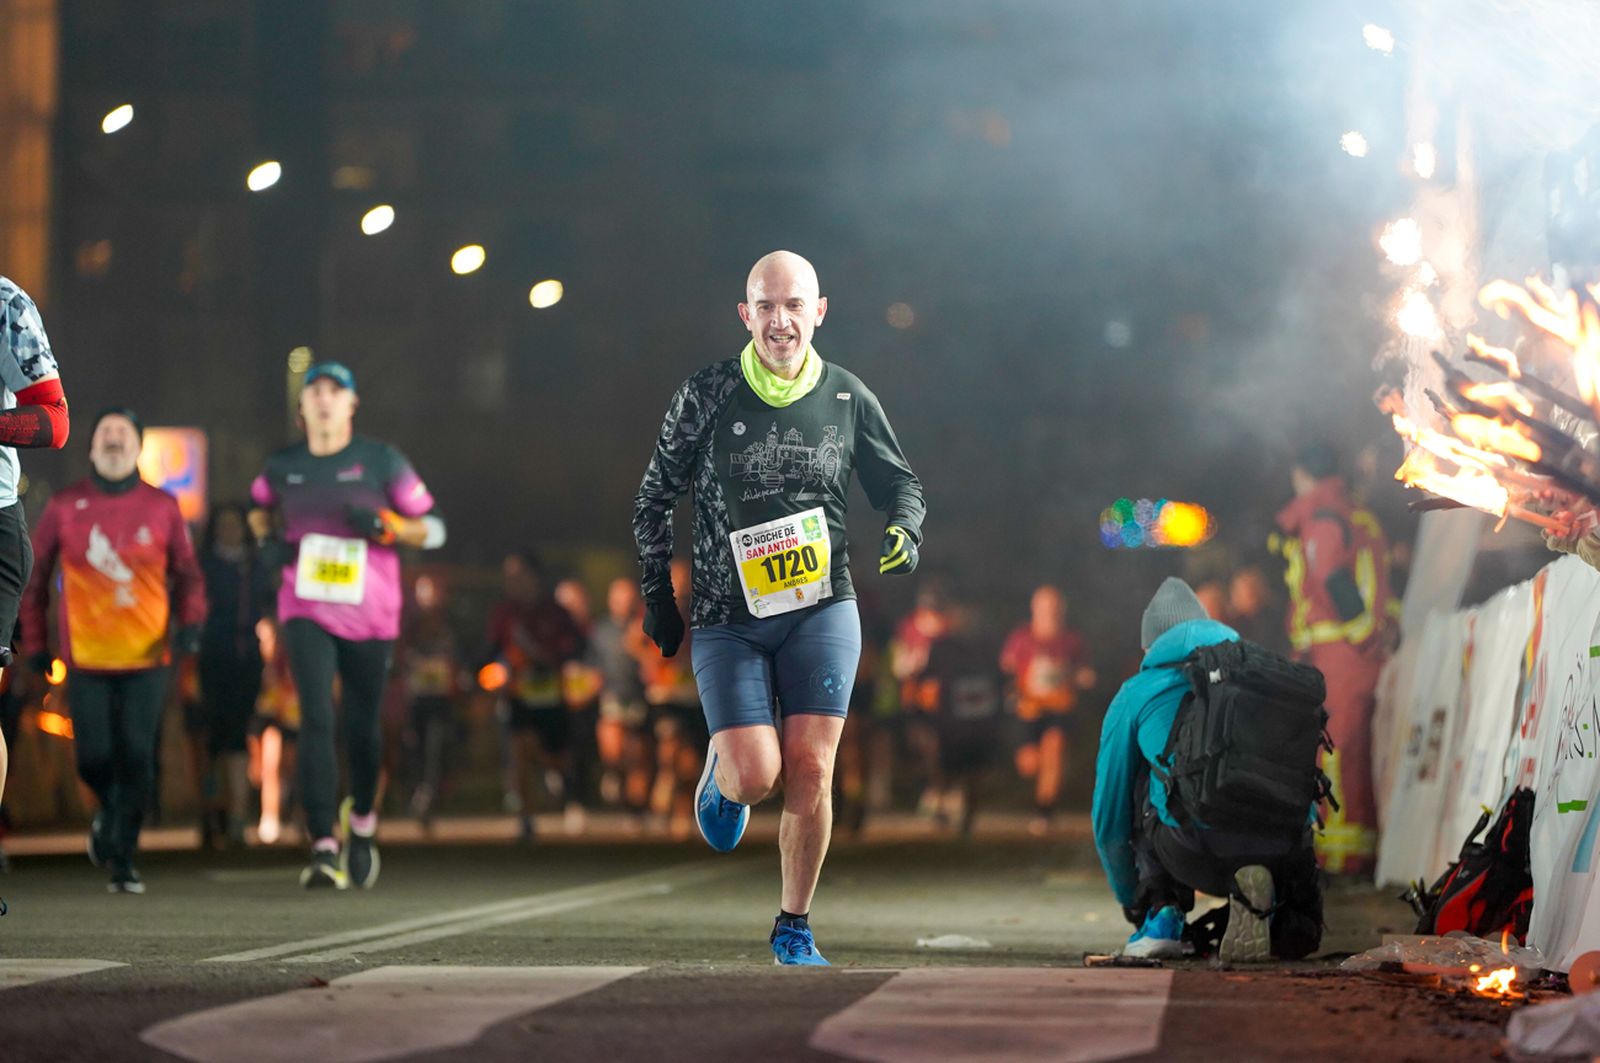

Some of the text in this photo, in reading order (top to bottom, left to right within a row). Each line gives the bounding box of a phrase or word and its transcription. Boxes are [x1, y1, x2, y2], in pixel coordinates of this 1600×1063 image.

[754, 530, 783, 545] NOCHE
[784, 526, 795, 537] DE
[746, 546, 765, 560] SAN
[761, 545, 818, 583] 1720
